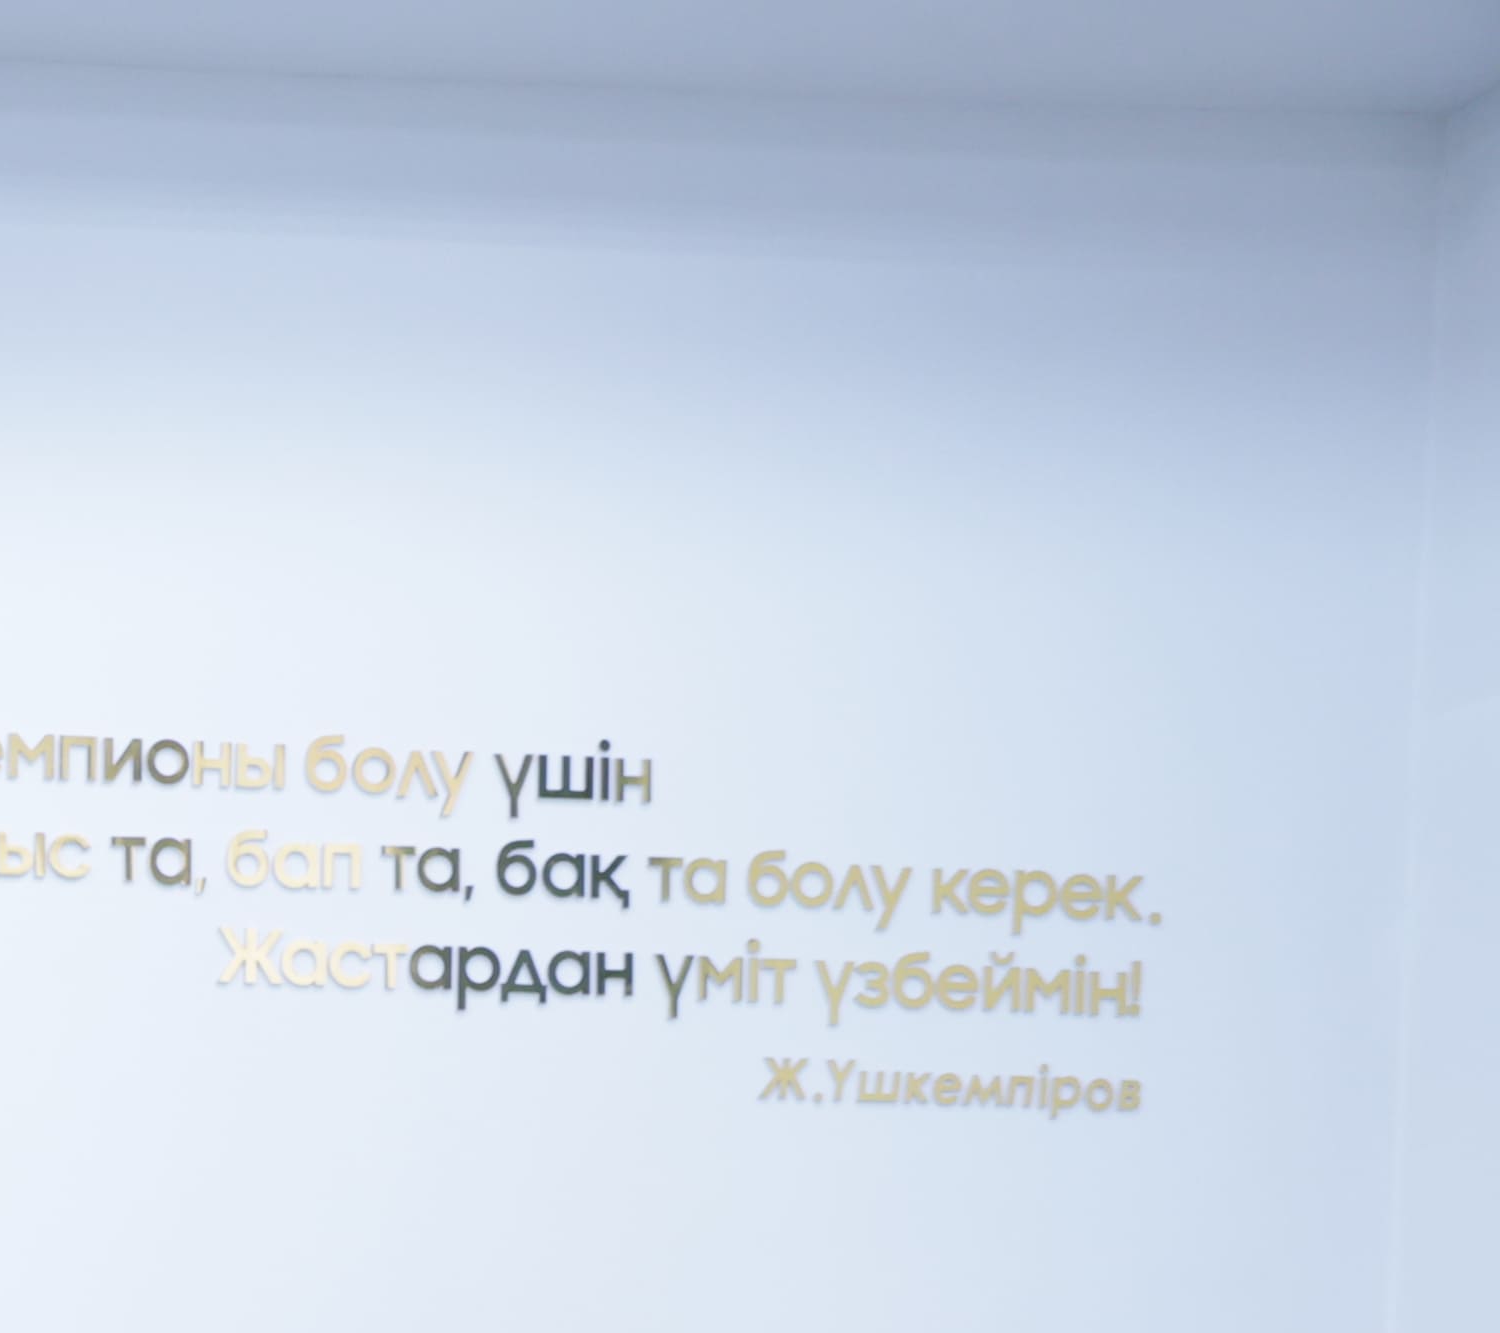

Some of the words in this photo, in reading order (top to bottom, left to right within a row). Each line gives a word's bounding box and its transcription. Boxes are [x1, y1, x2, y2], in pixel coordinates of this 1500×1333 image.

[306, 734, 473, 817] болу
[494, 739, 652, 818] үшін
[111, 836, 206, 896] та,
[227, 829, 361, 889] бап
[381, 845, 474, 901] та,
[497, 840, 630, 909] бақ
[648, 857, 727, 904] та
[748, 850, 912, 931] болу
[931, 867, 1162, 935] керек.
[218, 926, 633, 1011] Жастардан
[655, 939, 796, 1019] үміт
[816, 951, 1142, 1026] үзбеймін!
[759, 1057, 1141, 1119] Ж.Үшкемпіров
